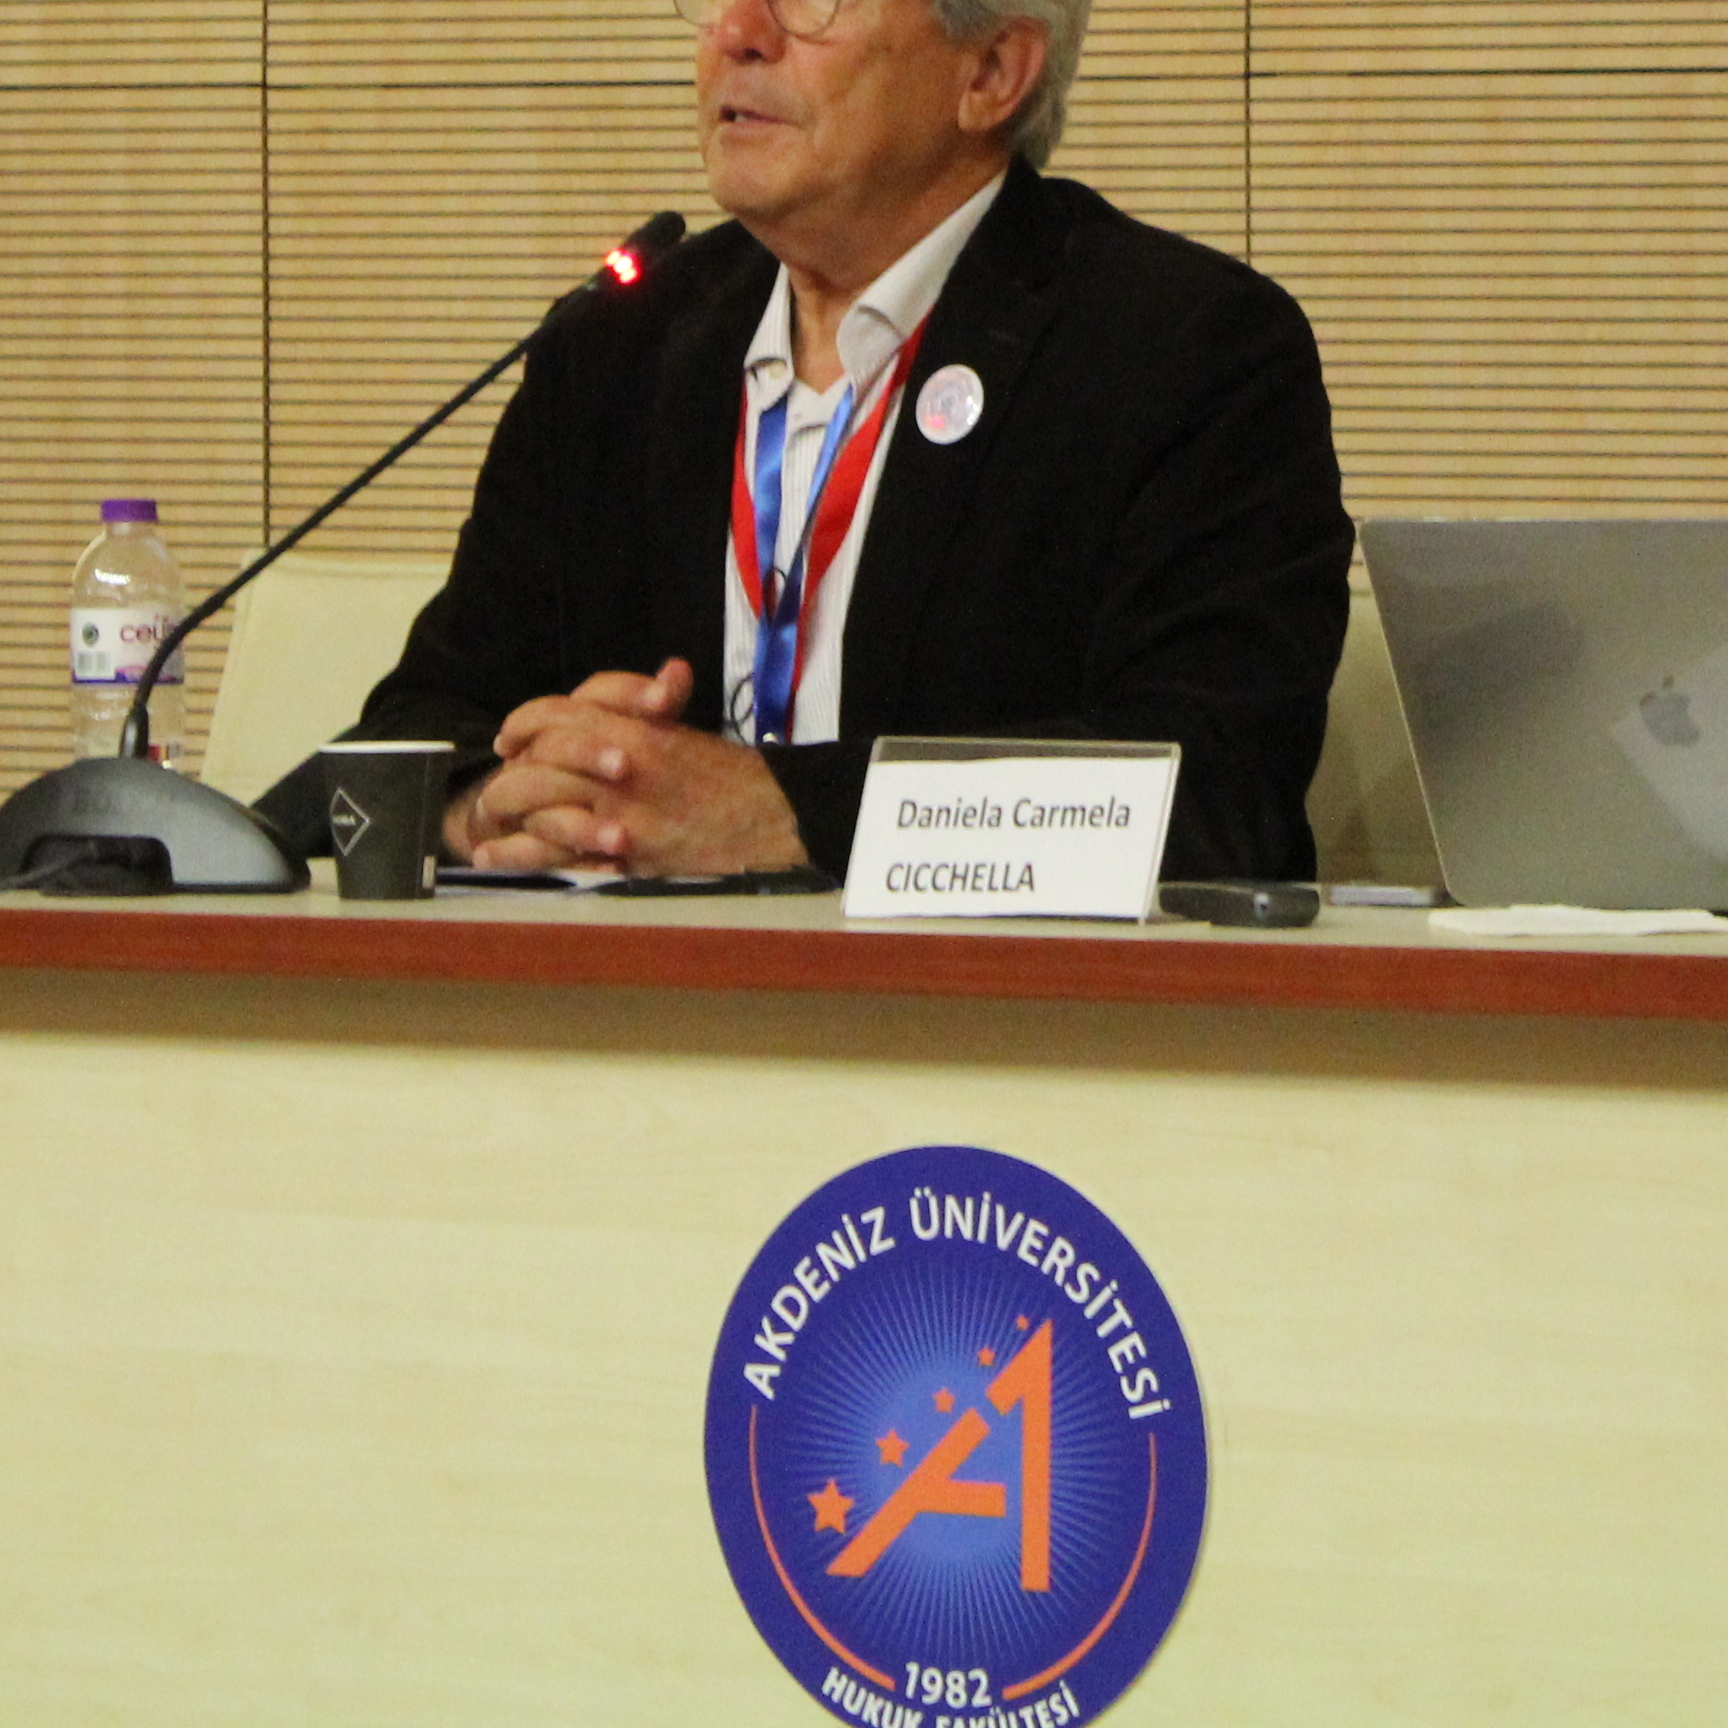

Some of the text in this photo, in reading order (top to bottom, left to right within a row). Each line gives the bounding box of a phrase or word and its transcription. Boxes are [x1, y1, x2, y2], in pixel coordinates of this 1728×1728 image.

[896, 795, 1131, 829] Daniela Carmela
[885, 862, 1036, 893] CICCHELLA
[743, 1186, 1172, 1420] AKDENİZ ÜNİVERSİTESİ
[905, 1661, 993, 1709] 1982
